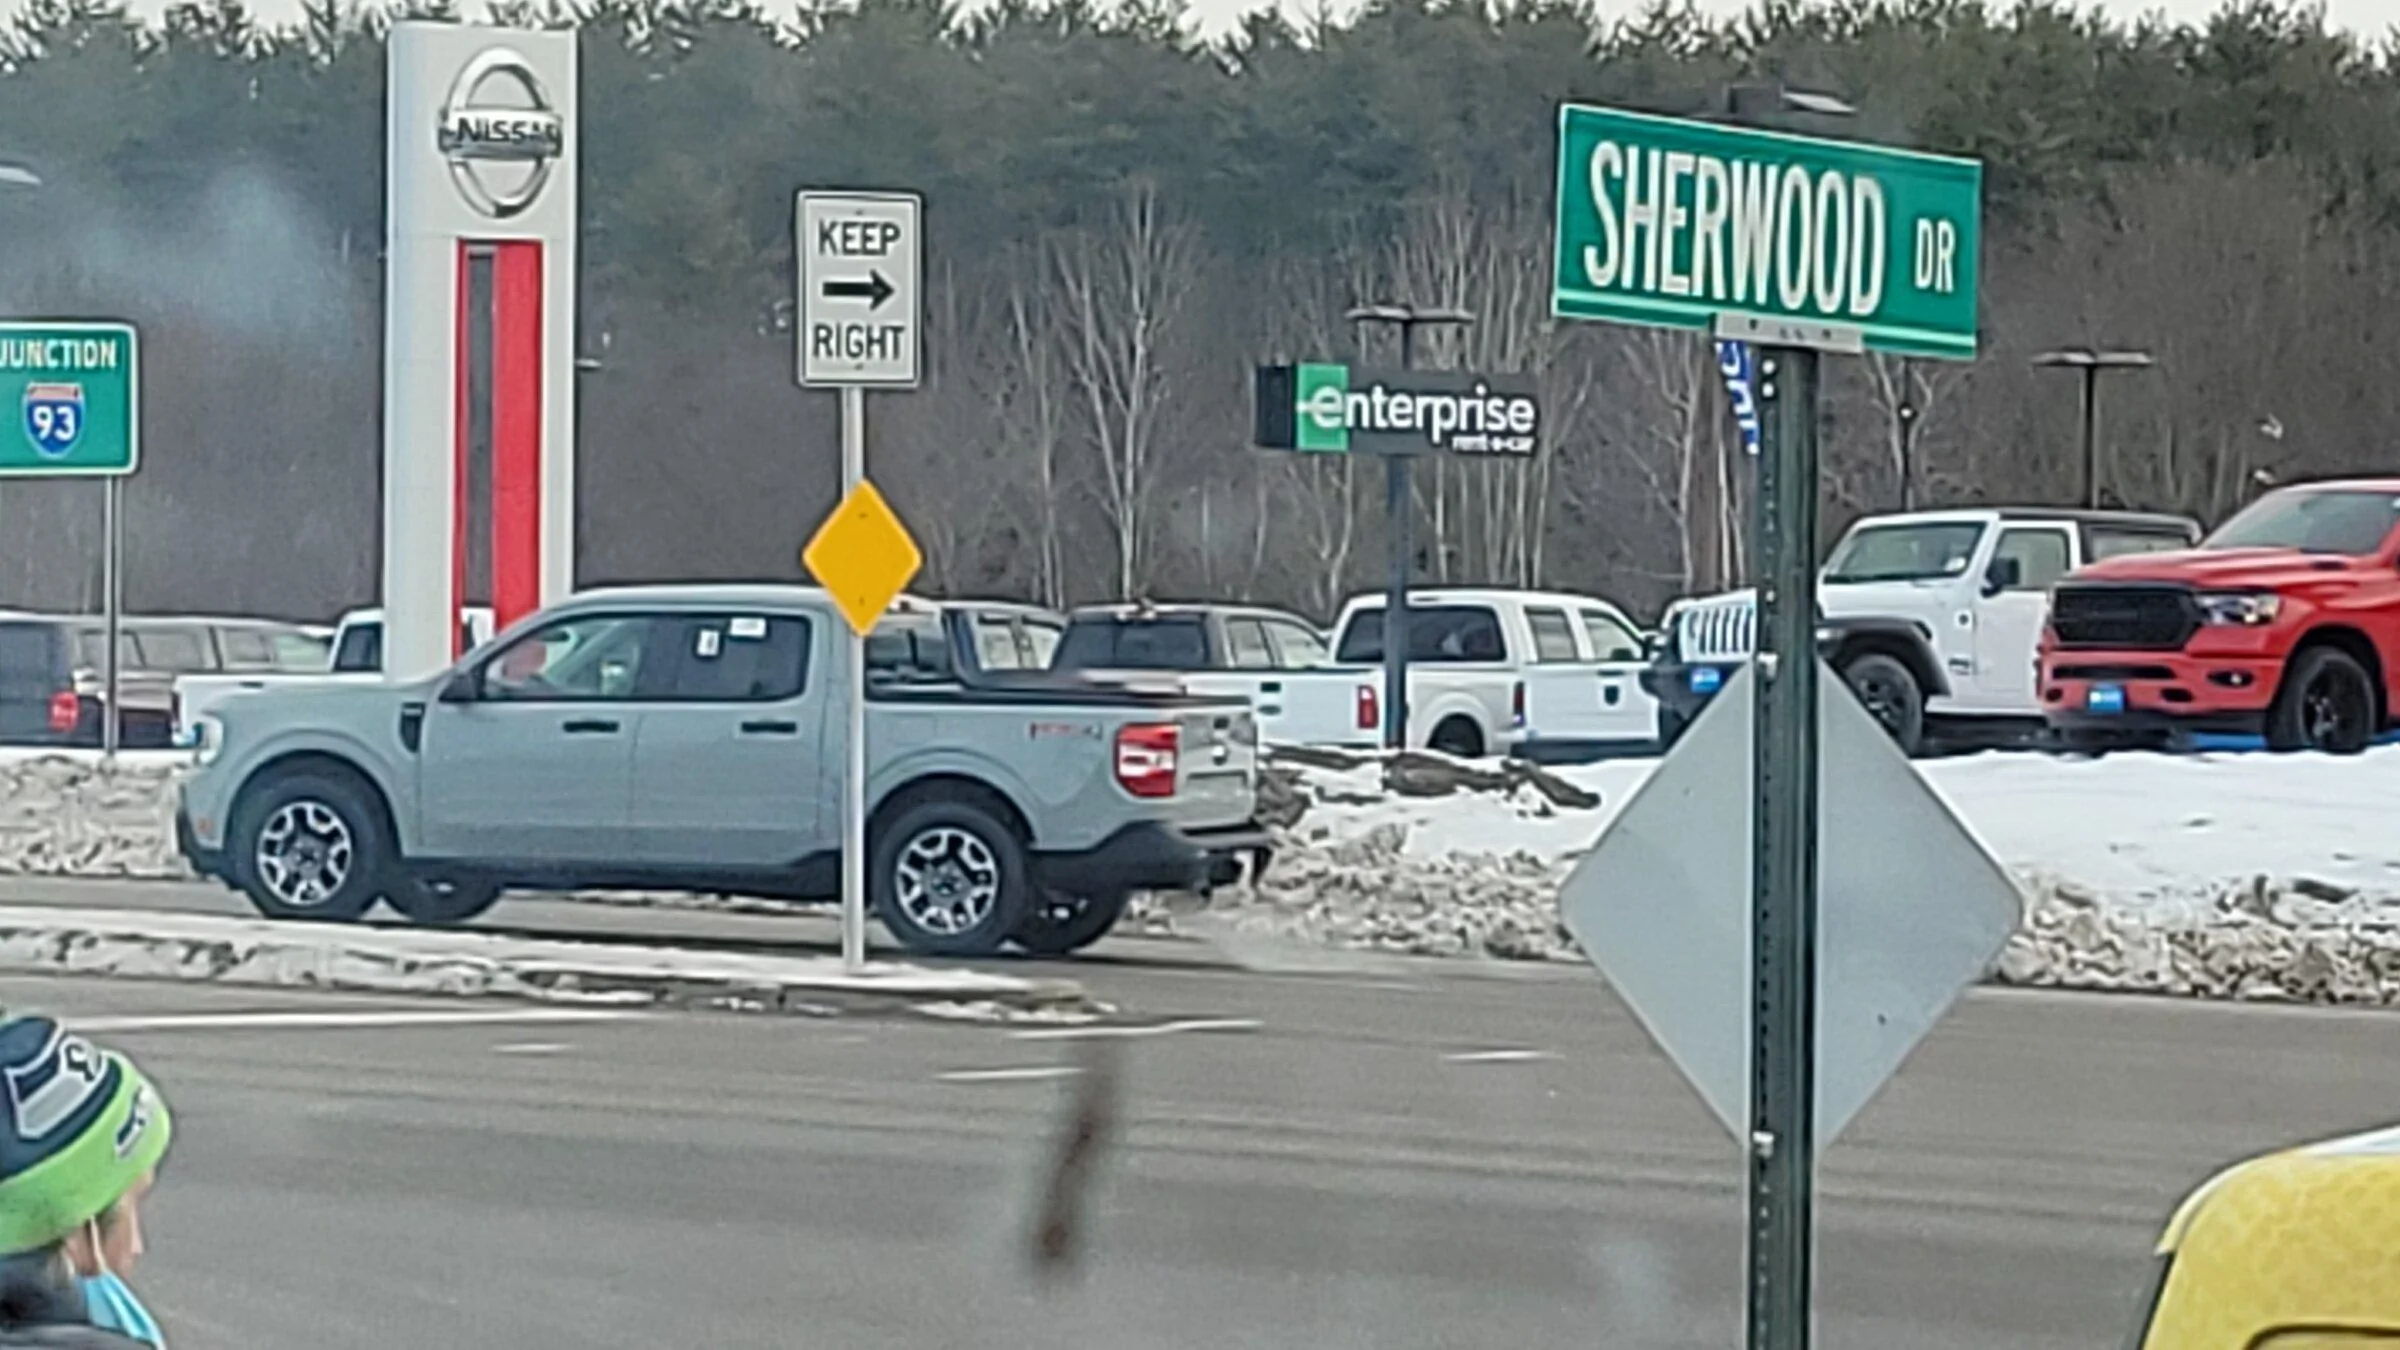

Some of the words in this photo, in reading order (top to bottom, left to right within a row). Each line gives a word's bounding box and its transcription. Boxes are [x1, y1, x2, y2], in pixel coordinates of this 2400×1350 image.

[818, 221, 901, 256] KEEP
[1583, 140, 1886, 316] SHERWOOD
[1914, 217, 1956, 293] DR
[813, 322, 904, 361] RIGHT
[33, 405, 75, 441] 93
[1296, 383, 1535, 444] enterprise
